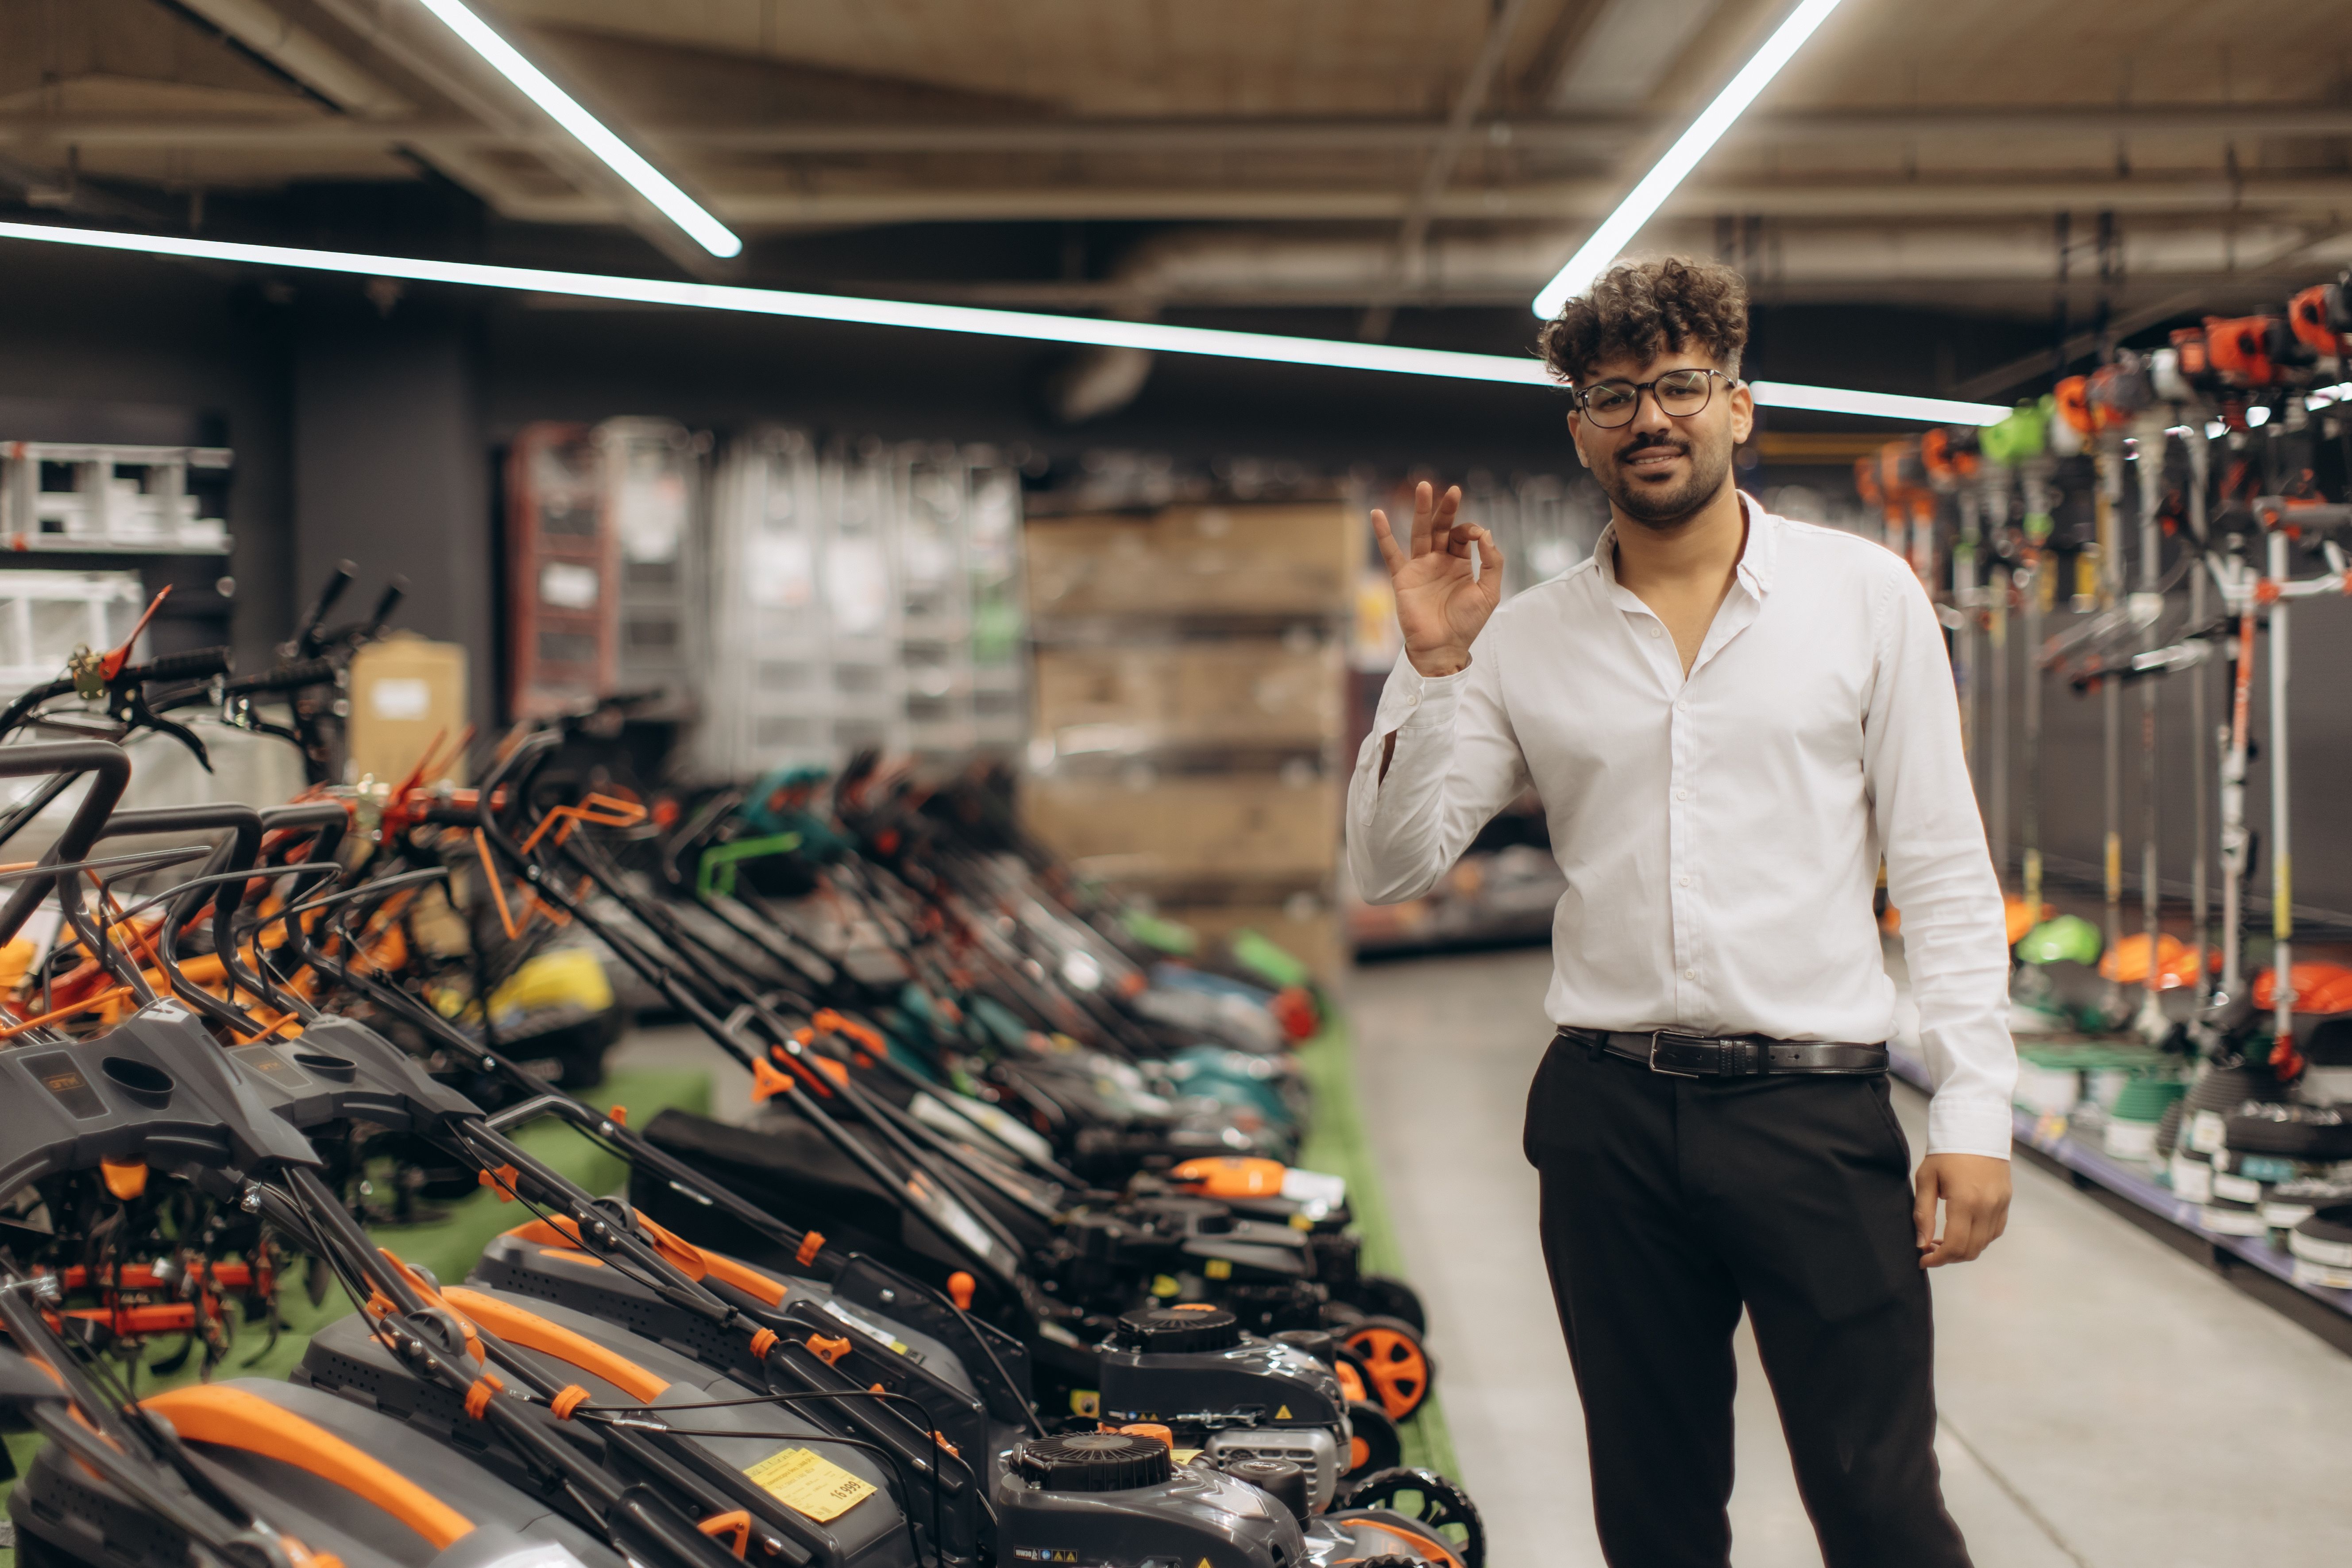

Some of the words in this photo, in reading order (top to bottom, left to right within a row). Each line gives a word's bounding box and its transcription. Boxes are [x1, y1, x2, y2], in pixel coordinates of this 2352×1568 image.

[830, 1489, 847, 1500] 16
[839, 1481, 861, 1494] 999
[1016, 1549, 1032, 1557] 10W30
